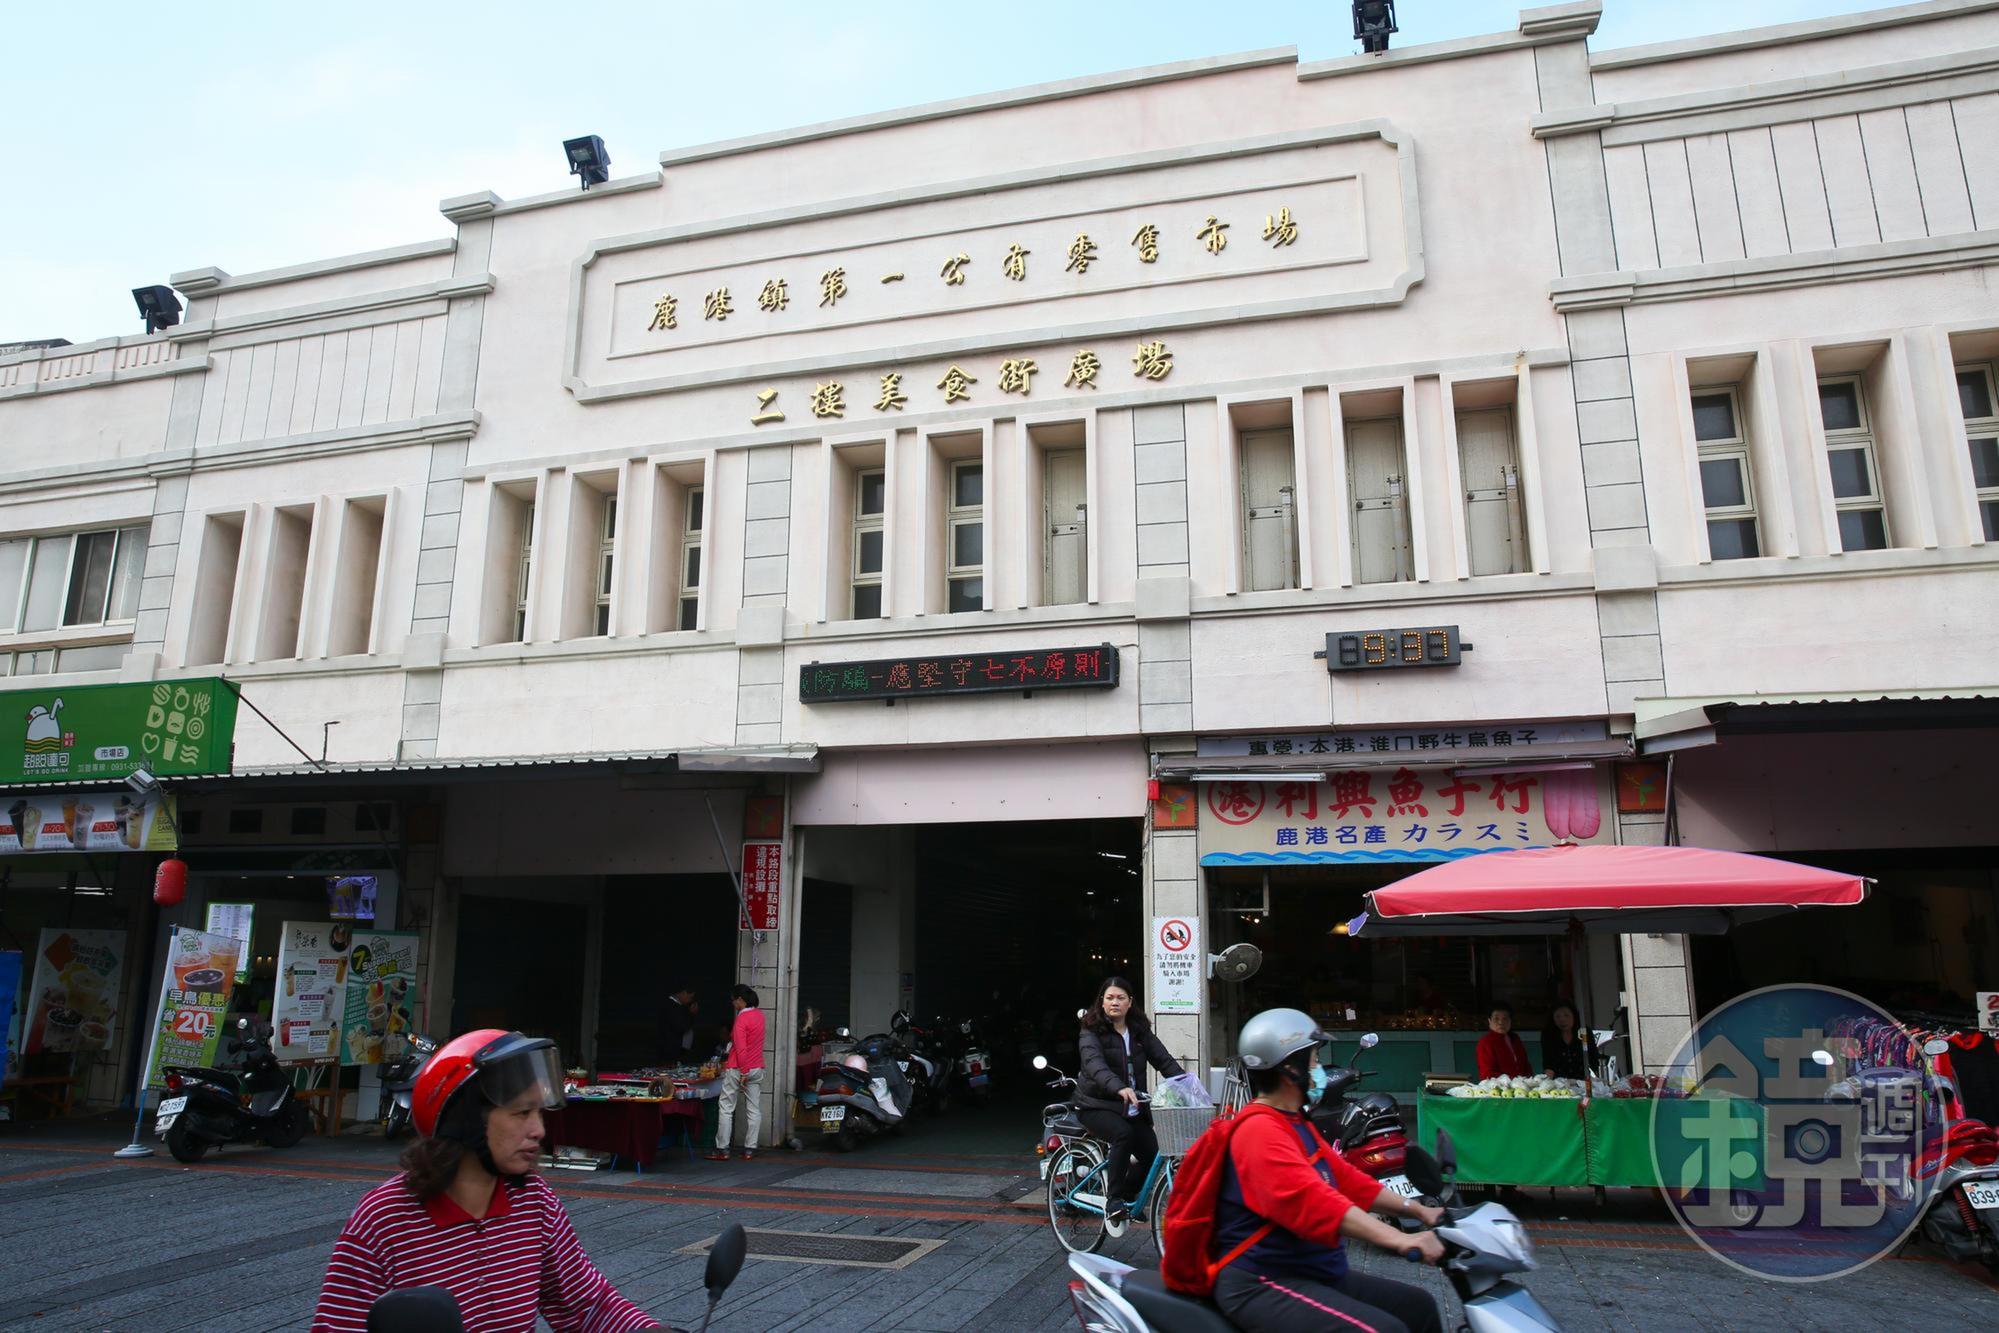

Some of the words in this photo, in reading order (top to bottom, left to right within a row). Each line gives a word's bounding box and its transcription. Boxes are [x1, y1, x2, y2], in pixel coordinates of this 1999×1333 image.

[648, 207, 1300, 332] 鹿港鎮第一公有零售市場
[750, 339, 1173, 425] 二樓美食街廣場
[101, 748, 124, 758] 市場店
[1275, 767, 1539, 820] 利興魚子行
[1276, 825, 1387, 846] 鹿港名產
[1402, 822, 1530, 843] カラスミ
[766, 846, 780, 928] 本路段重點取締
[176, 1011, 209, 1035] 20
